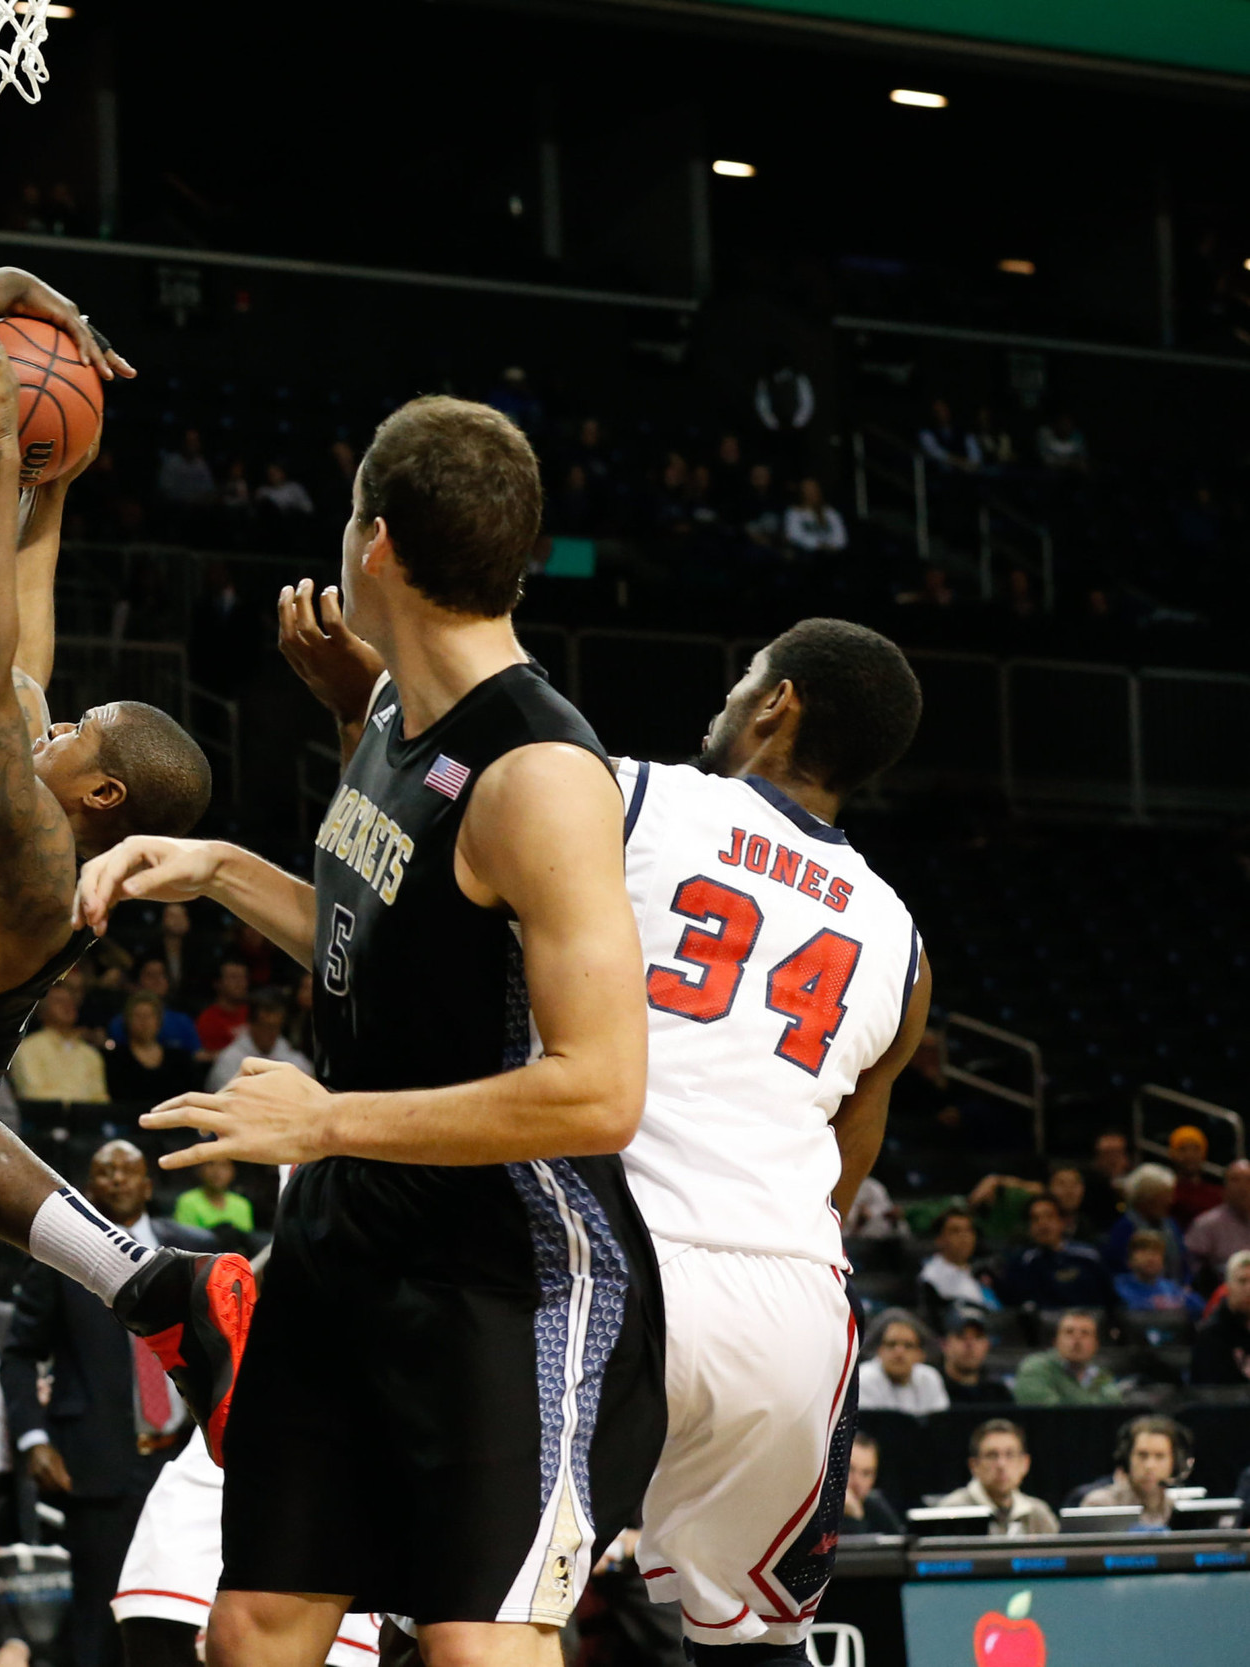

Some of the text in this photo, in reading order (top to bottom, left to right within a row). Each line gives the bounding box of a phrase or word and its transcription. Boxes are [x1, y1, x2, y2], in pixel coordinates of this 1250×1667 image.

[717, 826, 854, 913] JONES
[324, 902, 356, 997] 5
[646, 873, 863, 1079] 34
